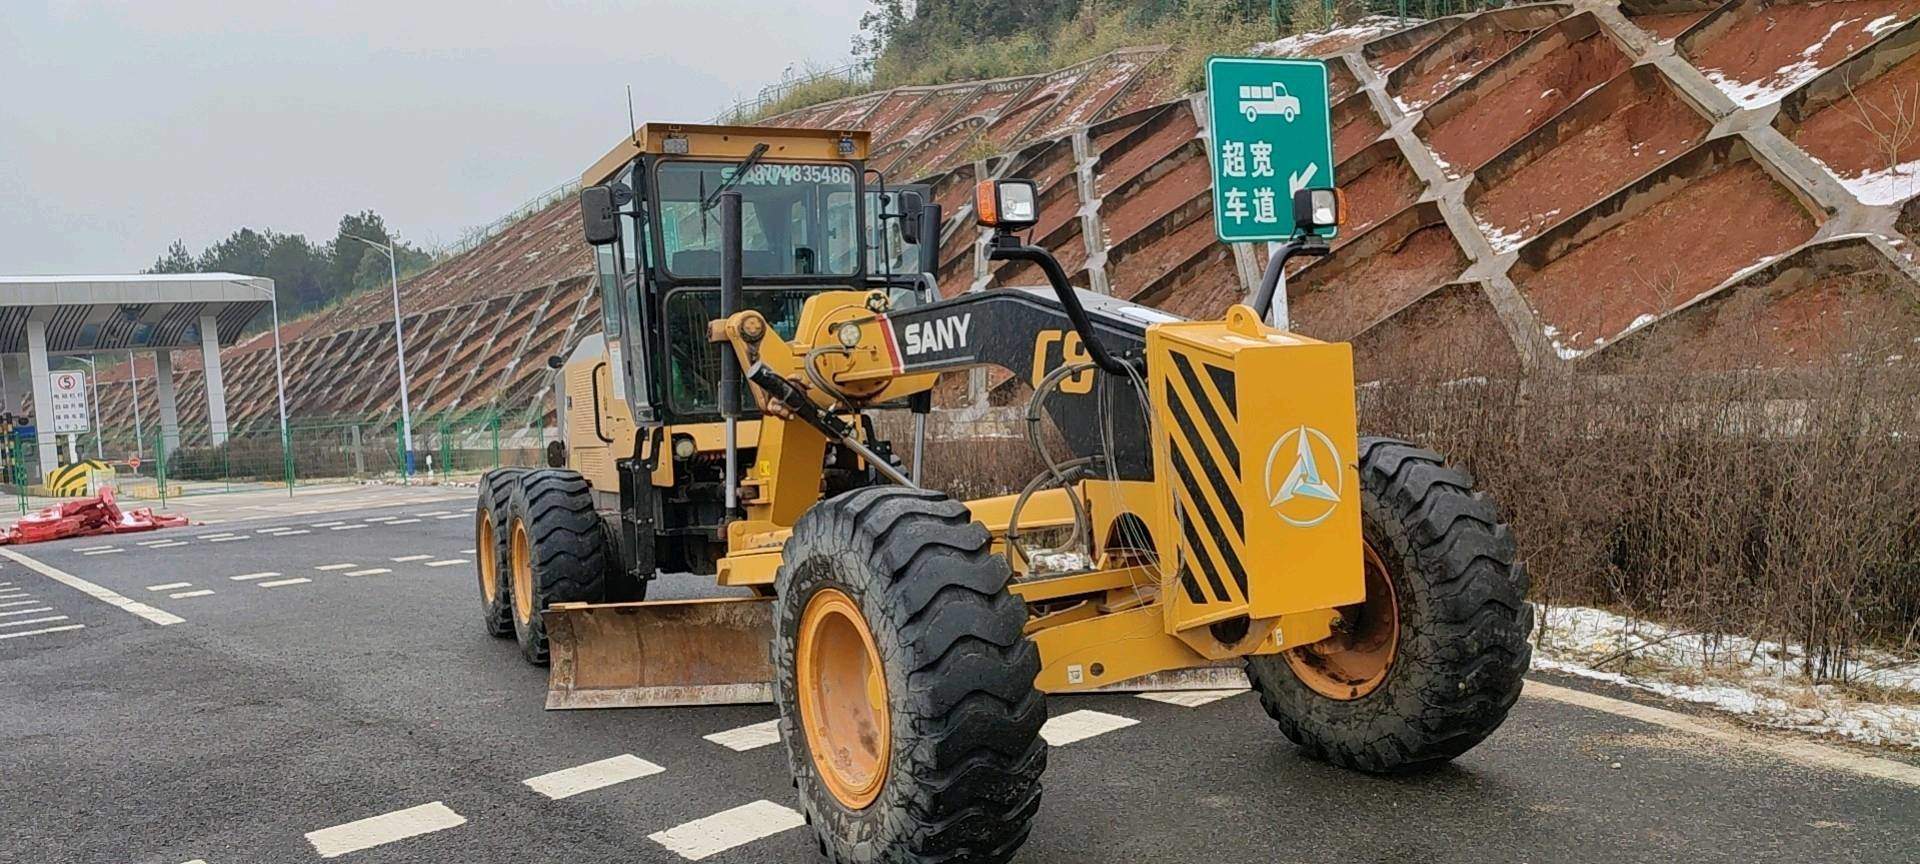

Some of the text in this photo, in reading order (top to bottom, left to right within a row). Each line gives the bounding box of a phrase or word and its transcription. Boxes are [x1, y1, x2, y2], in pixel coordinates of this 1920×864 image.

[1222, 140, 1275, 177] 超宽
[1224, 187, 1278, 224] 车道
[904, 313, 971, 355] SANY
[63, 376, 72, 390] 5
